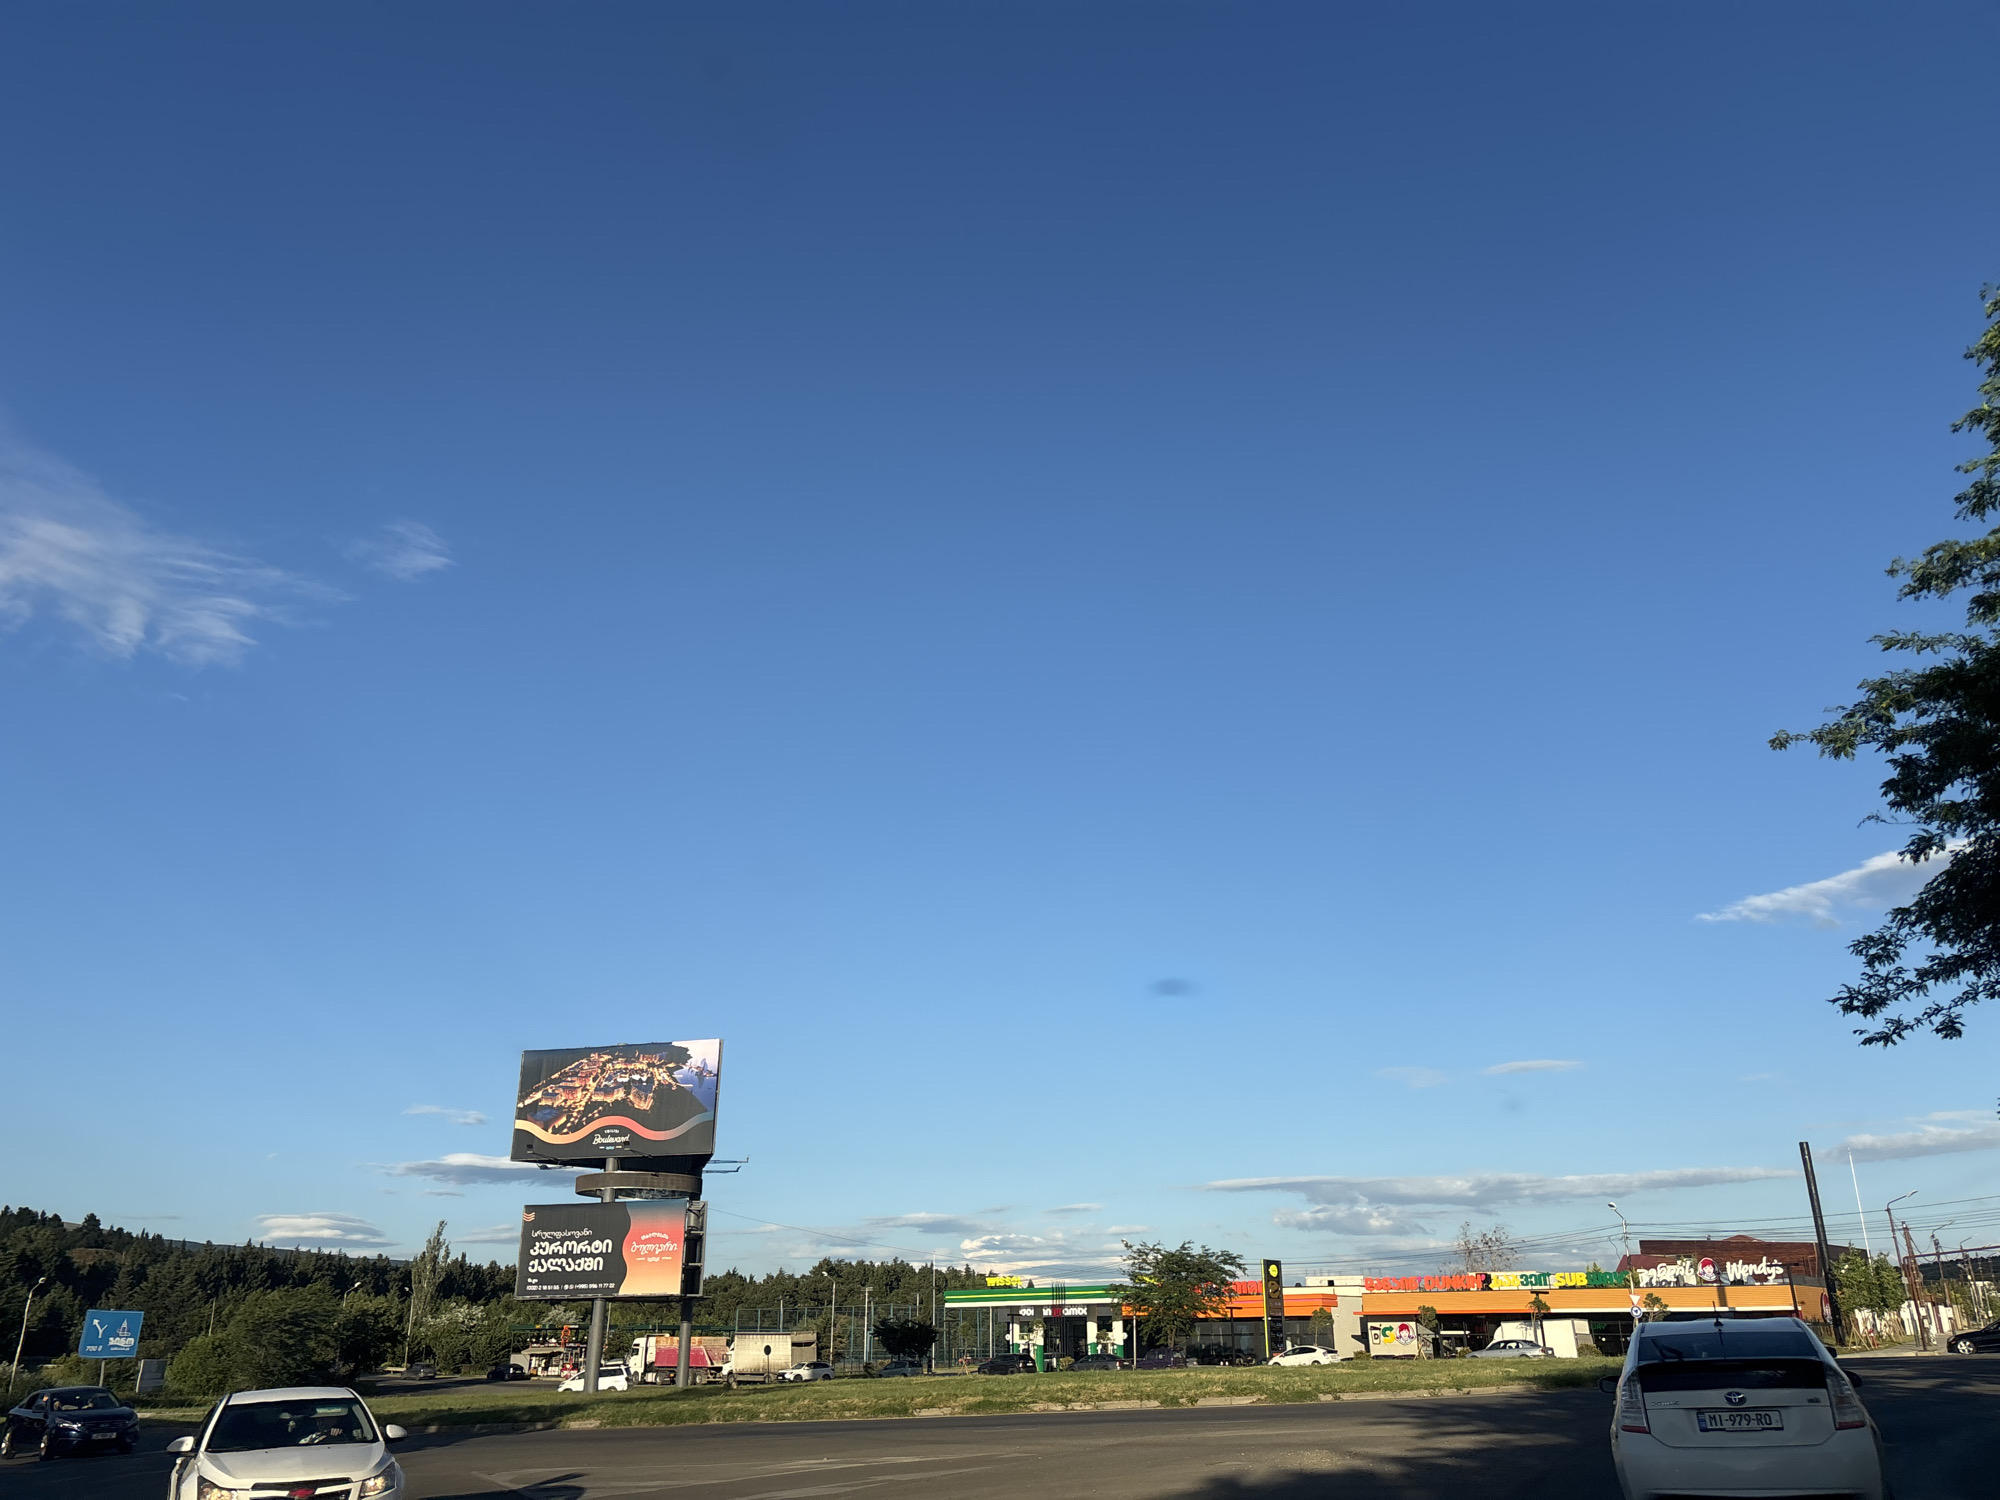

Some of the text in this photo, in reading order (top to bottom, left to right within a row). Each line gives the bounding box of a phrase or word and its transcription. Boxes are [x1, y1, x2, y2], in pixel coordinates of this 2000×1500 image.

[592, 1133, 631, 1145] Boulevard
[531, 1228, 593, 1240] სრულფასოვანი
[529, 1239, 613, 1256] კურორტი
[528, 1257, 604, 1273] ქალაქში
[1726, 1256, 1785, 1281] Wendy's
[1424, 1274, 1486, 1290] DUNKIN'
[1553, 1271, 1629, 1287] SUBWAY
[1708, 1413, 1773, 1427] MI-979-RO
